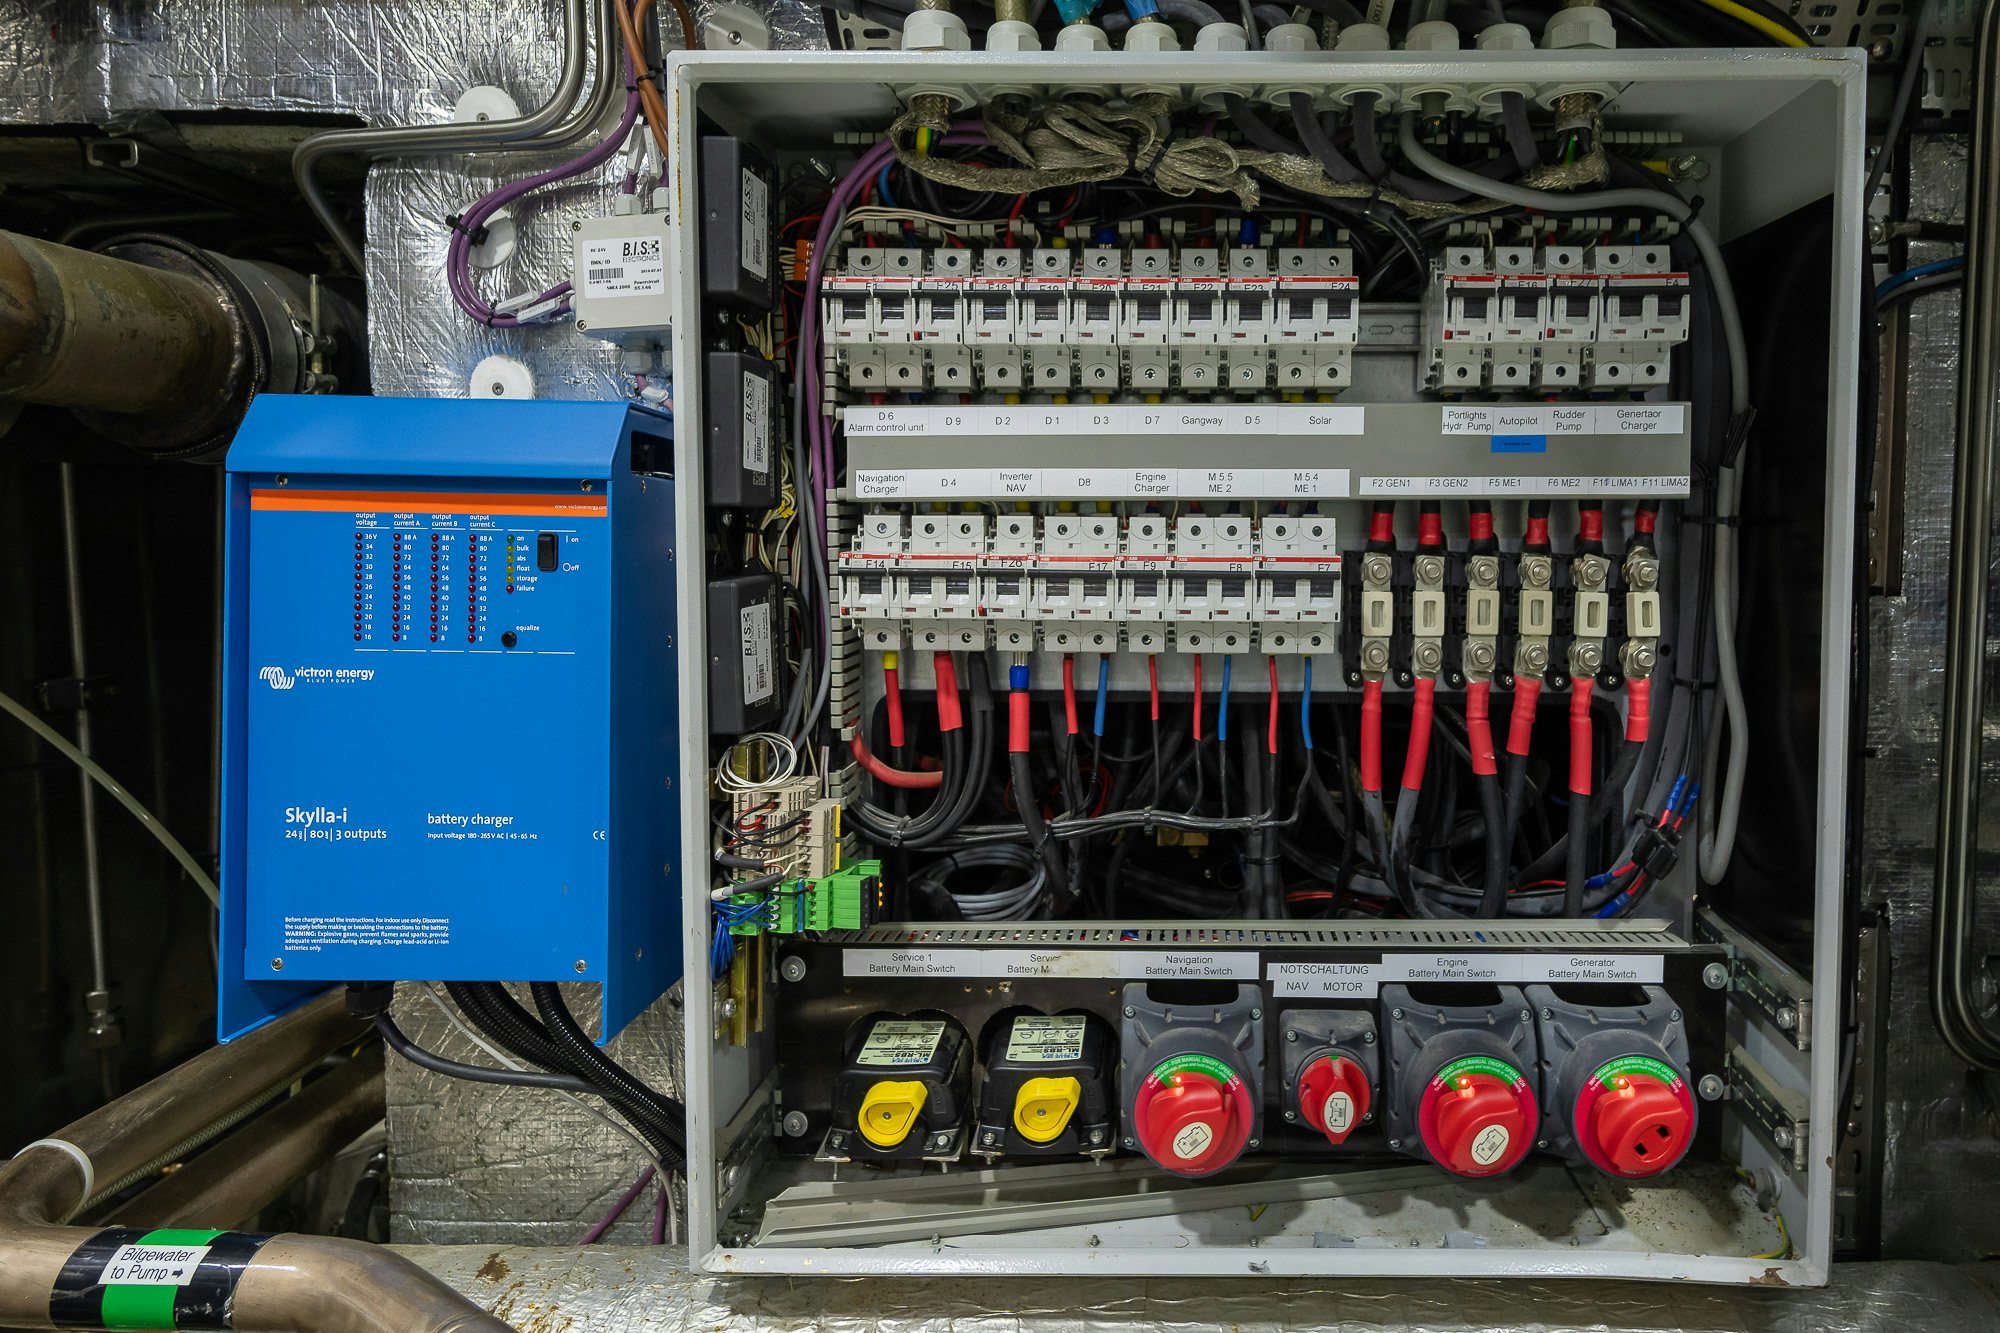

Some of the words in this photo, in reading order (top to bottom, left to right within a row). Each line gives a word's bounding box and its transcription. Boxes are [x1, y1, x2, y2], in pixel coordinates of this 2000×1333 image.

[743, 187, 752, 222] B.I.S.
[623, 241, 650, 257] B.I.S.
[622, 255, 660, 263] ELECTRONICS
[936, 281, 959, 290] F25
[988, 283, 1007, 291] F18
[1142, 283, 1161, 291] F21
[1193, 283, 1213, 291] F22
[1244, 283, 1264, 291] F23
[1331, 282, 1351, 290] F24
[745, 390, 753, 423] B.I.S.
[878, 412, 886, 421] D
[887, 412, 894, 421] 6
[1448, 411, 1487, 421] Portlights
[1553, 410, 1586, 419] Rudder
[1616, 409, 1662, 419] Genertaor
[945, 416, 953, 426] D
[955, 416, 962, 426] 9
[995, 416, 1003, 426] D
[1004, 416, 1011, 426] 2
[1045, 416, 1053, 425] D
[1093, 415, 1101, 425] D
[1103, 415, 1110, 425] 3
[1144, 415, 1152, 425] D
[1154, 415, 1160, 425] 7
[1181, 415, 1223, 427] Gangway
[1245, 415, 1253, 425] D
[1254, 415, 1261, 425] 5
[1308, 415, 1333, 425] Solar
[1499, 416, 1538, 427] Autopilot
[848, 423, 873, 432] Alarm
[875, 423, 906, 432] control
[908, 423, 924, 432] unit
[1443, 422, 1463, 432] Hydr
[1467, 422, 1492, 432] Pump
[1555, 421, 1582, 432] Pump
[1620, 421, 1657, 432] Charger
[858, 473, 905, 484] Navigation
[999, 472, 1033, 482] Inverter
[1135, 472, 1167, 483] Engine
[1208, 473, 1217, 481] M
[1218, 472, 1233, 482] 5.5
[1294, 473, 1303, 481] M
[1304, 472, 1319, 482] 5.4
[1642, 478, 1658, 487] F11
[1661, 477, 1689, 487] LIMA2
[941, 478, 949, 487] D
[950, 478, 957, 487] 4
[1078, 478, 1091, 487] D8
[1372, 478, 1384, 487] F2
[1386, 478, 1411, 488] GEN1
[1429, 478, 1441, 487] F3
[1442, 478, 1469, 488] GEN2
[1488, 478, 1500, 487] F5
[1502, 478, 1521, 487] ME1
[1547, 478, 1559, 487] F6
[1561, 478, 1581, 488] ME2
[1611, 478, 1638, 487] LIMA1
[863, 484, 899, 495] Charger
[1006, 483, 1027, 493] NAV
[1134, 483, 1170, 494] Charger
[1208, 484, 1223, 493] ME
[1225, 484, 1232, 493] 2
[1295, 484, 1309, 493] ME
[355, 519, 378, 527] voltage
[866, 559, 885, 569] F14
[953, 560, 972, 569] F15
[1001, 559, 1023, 568] F26
[1089, 562, 1108, 571] F17
[1143, 561, 1156, 571] F9
[1229, 562, 1243, 572] F8
[1317, 563, 1331, 572] F7
[516, 575, 538, 583] storage
[515, 624, 540, 633] equalize
[744, 623, 753, 656] B.I.S.
[294, 666, 333, 678] victron
[335, 669, 375, 681] energy
[285, 806, 348, 829] Skylla-i
[427, 813, 469, 828] battery
[471, 813, 514, 828] charger
[335, 830, 342, 841] 3
[344, 828, 387, 842] outputs
[427, 832, 443, 840] Input
[444, 832, 466, 841] voltage
[891, 952, 925, 962] Service
[1030, 953, 1061, 963] Servi
[1165, 955, 1213, 965] Navigation
[1436, 957, 1469, 968] Engine
[1570, 958, 1616, 967] Generator
[869, 964, 900, 974] Battery
[902, 964, 925, 973] Main
[926, 964, 956, 973] Switch
[1007, 964, 1039, 975] Battery
[1145, 967, 1177, 977] Battery
[1179, 967, 1201, 976] Main
[1203, 966, 1233, 976] Switch
[1280, 964, 1370, 975] NOTSCHALTUNG
[1408, 969, 1440, 980] Battery
[1442, 969, 1465, 978] Main
[1466, 968, 1496, 978] Switch
[1548, 969, 1581, 980] Battery
[1582, 969, 1605, 979] Main
[1607, 969, 1637, 979] Switch
[1286, 981, 1309, 991] NAV
[1323, 981, 1363, 992] MOTOR
[120, 1247, 196, 1264] Bilgewater
[110, 1265, 125, 1280] to
[127, 1264, 169, 1283] Pump
